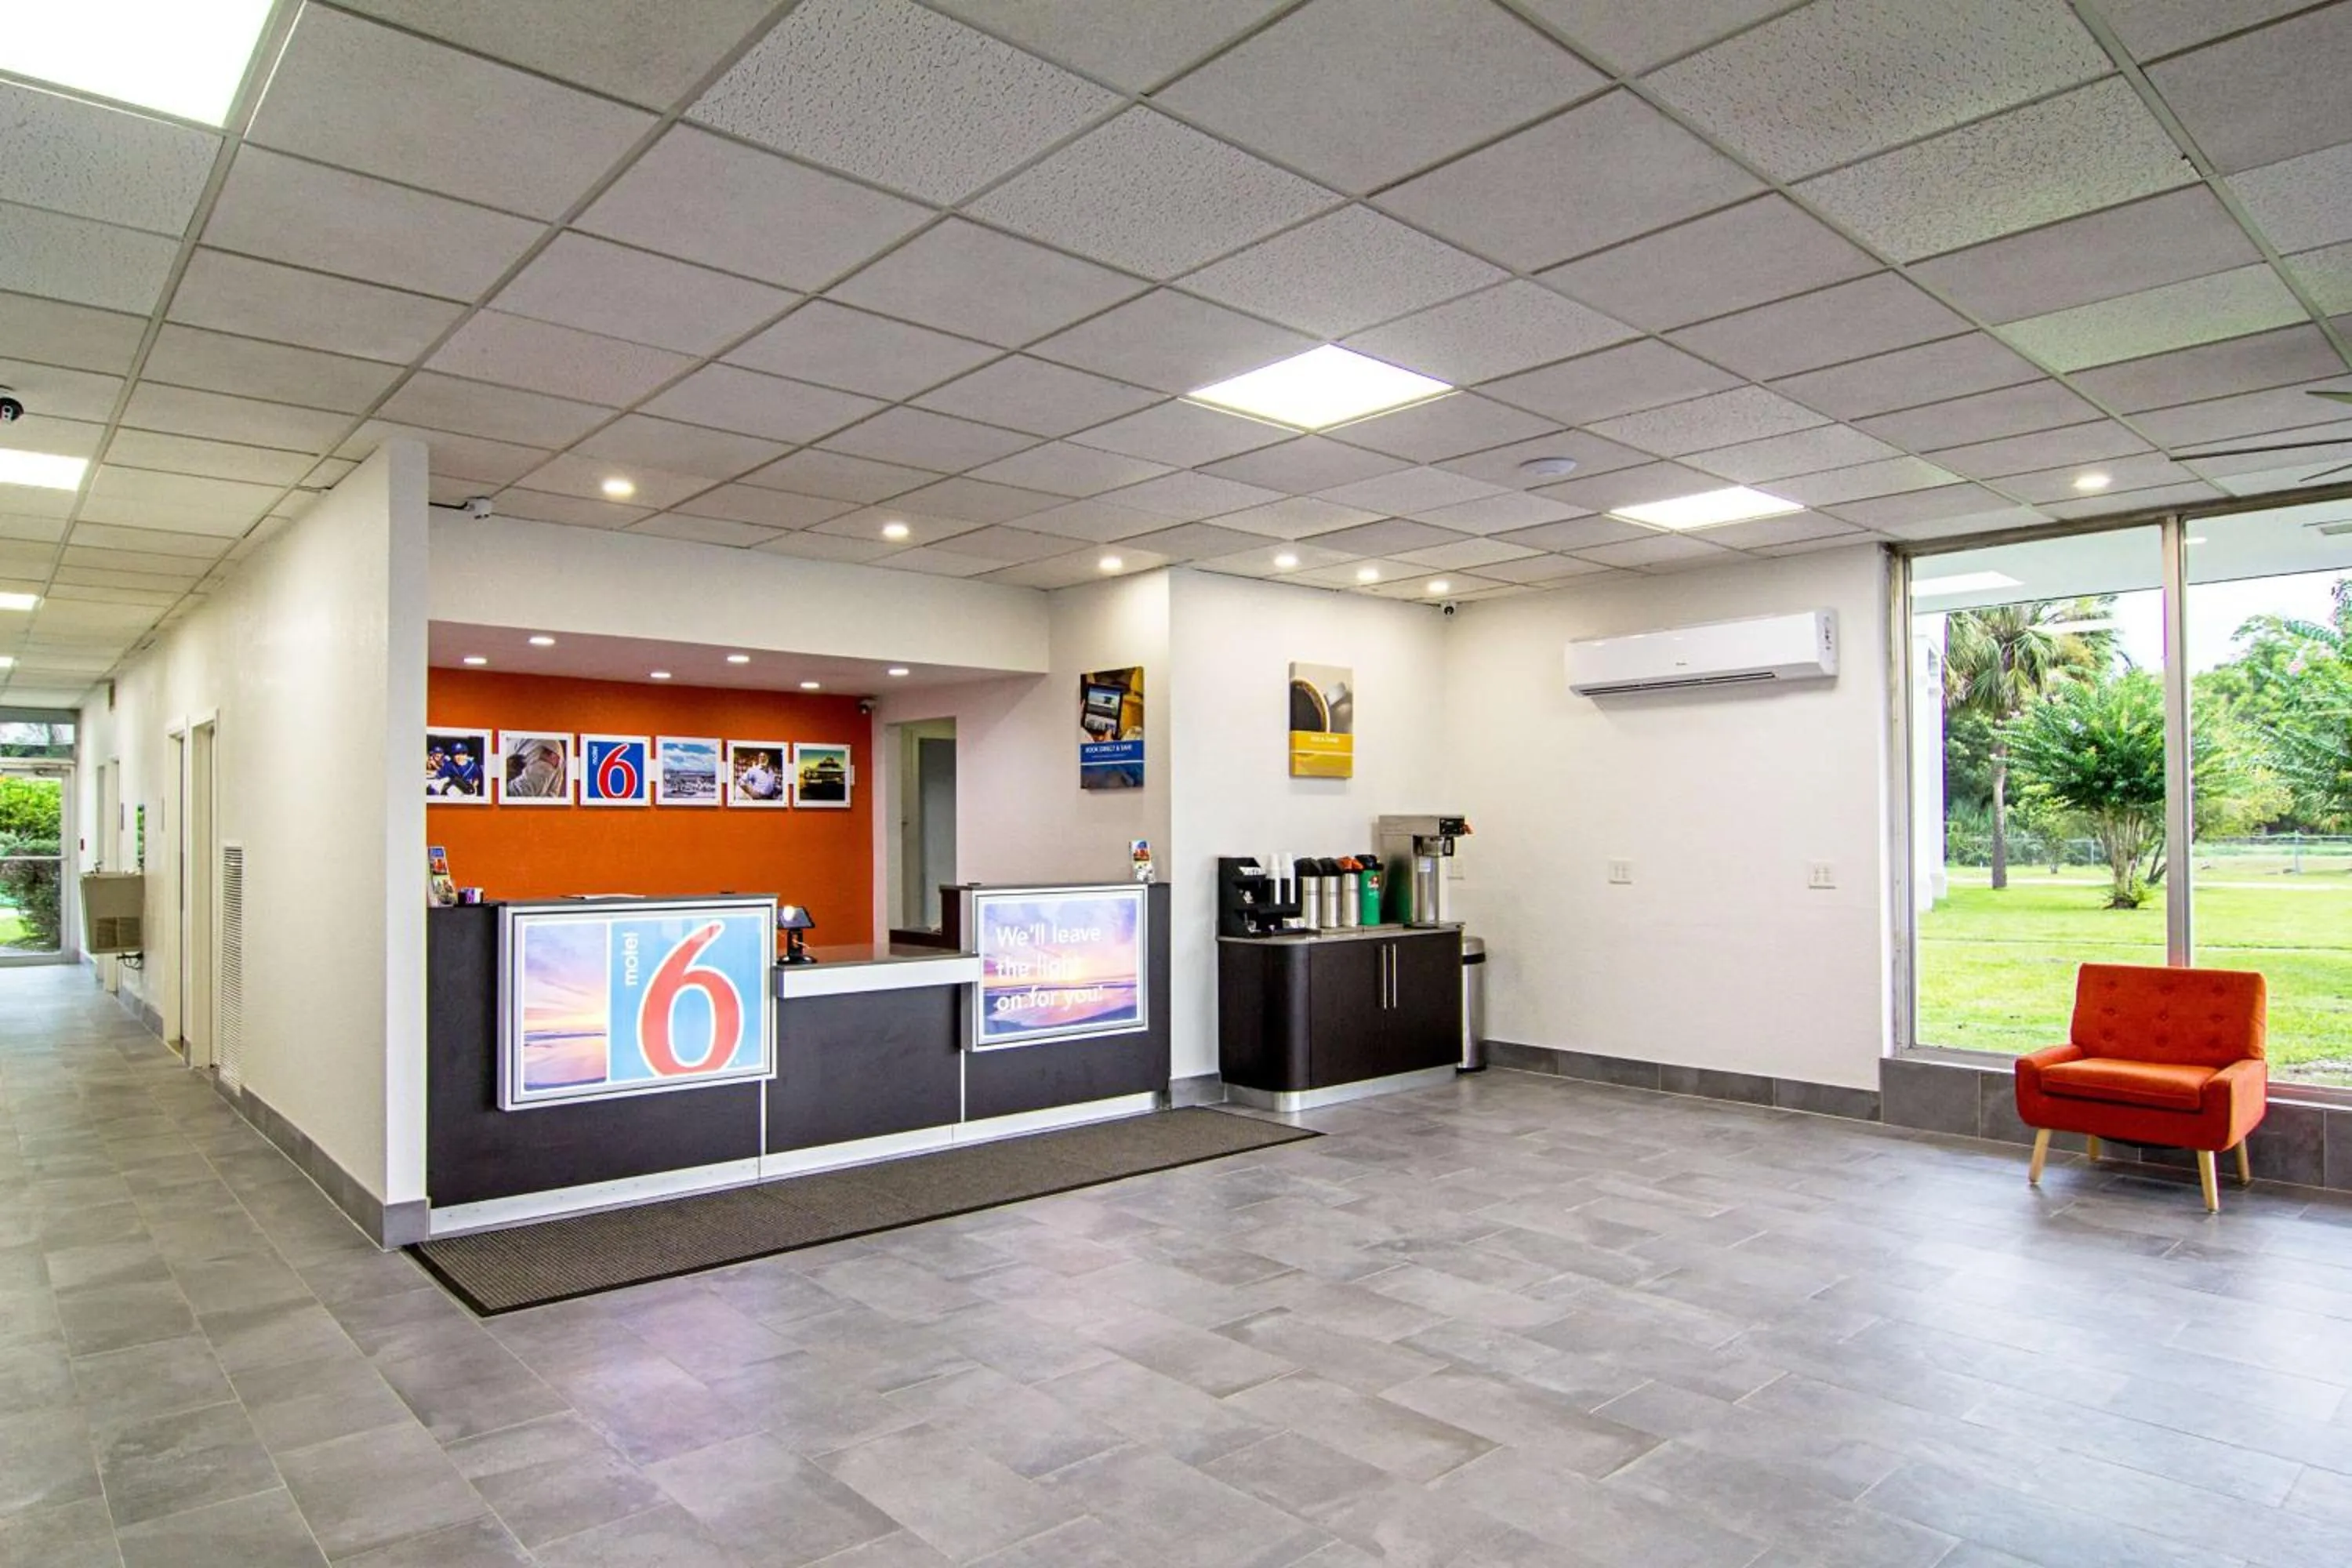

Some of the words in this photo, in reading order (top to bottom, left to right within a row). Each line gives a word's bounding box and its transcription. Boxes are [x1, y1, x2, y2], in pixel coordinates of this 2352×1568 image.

[597, 742, 637, 799] 6
[996, 923, 1045, 947] We'll
[1052, 923, 1102, 943] leave
[622, 932, 639, 986] motel
[995, 956, 1029, 978] the
[636, 919, 743, 1077] 6
[996, 996, 1022, 1011] on
[1028, 985, 1056, 1008] for
